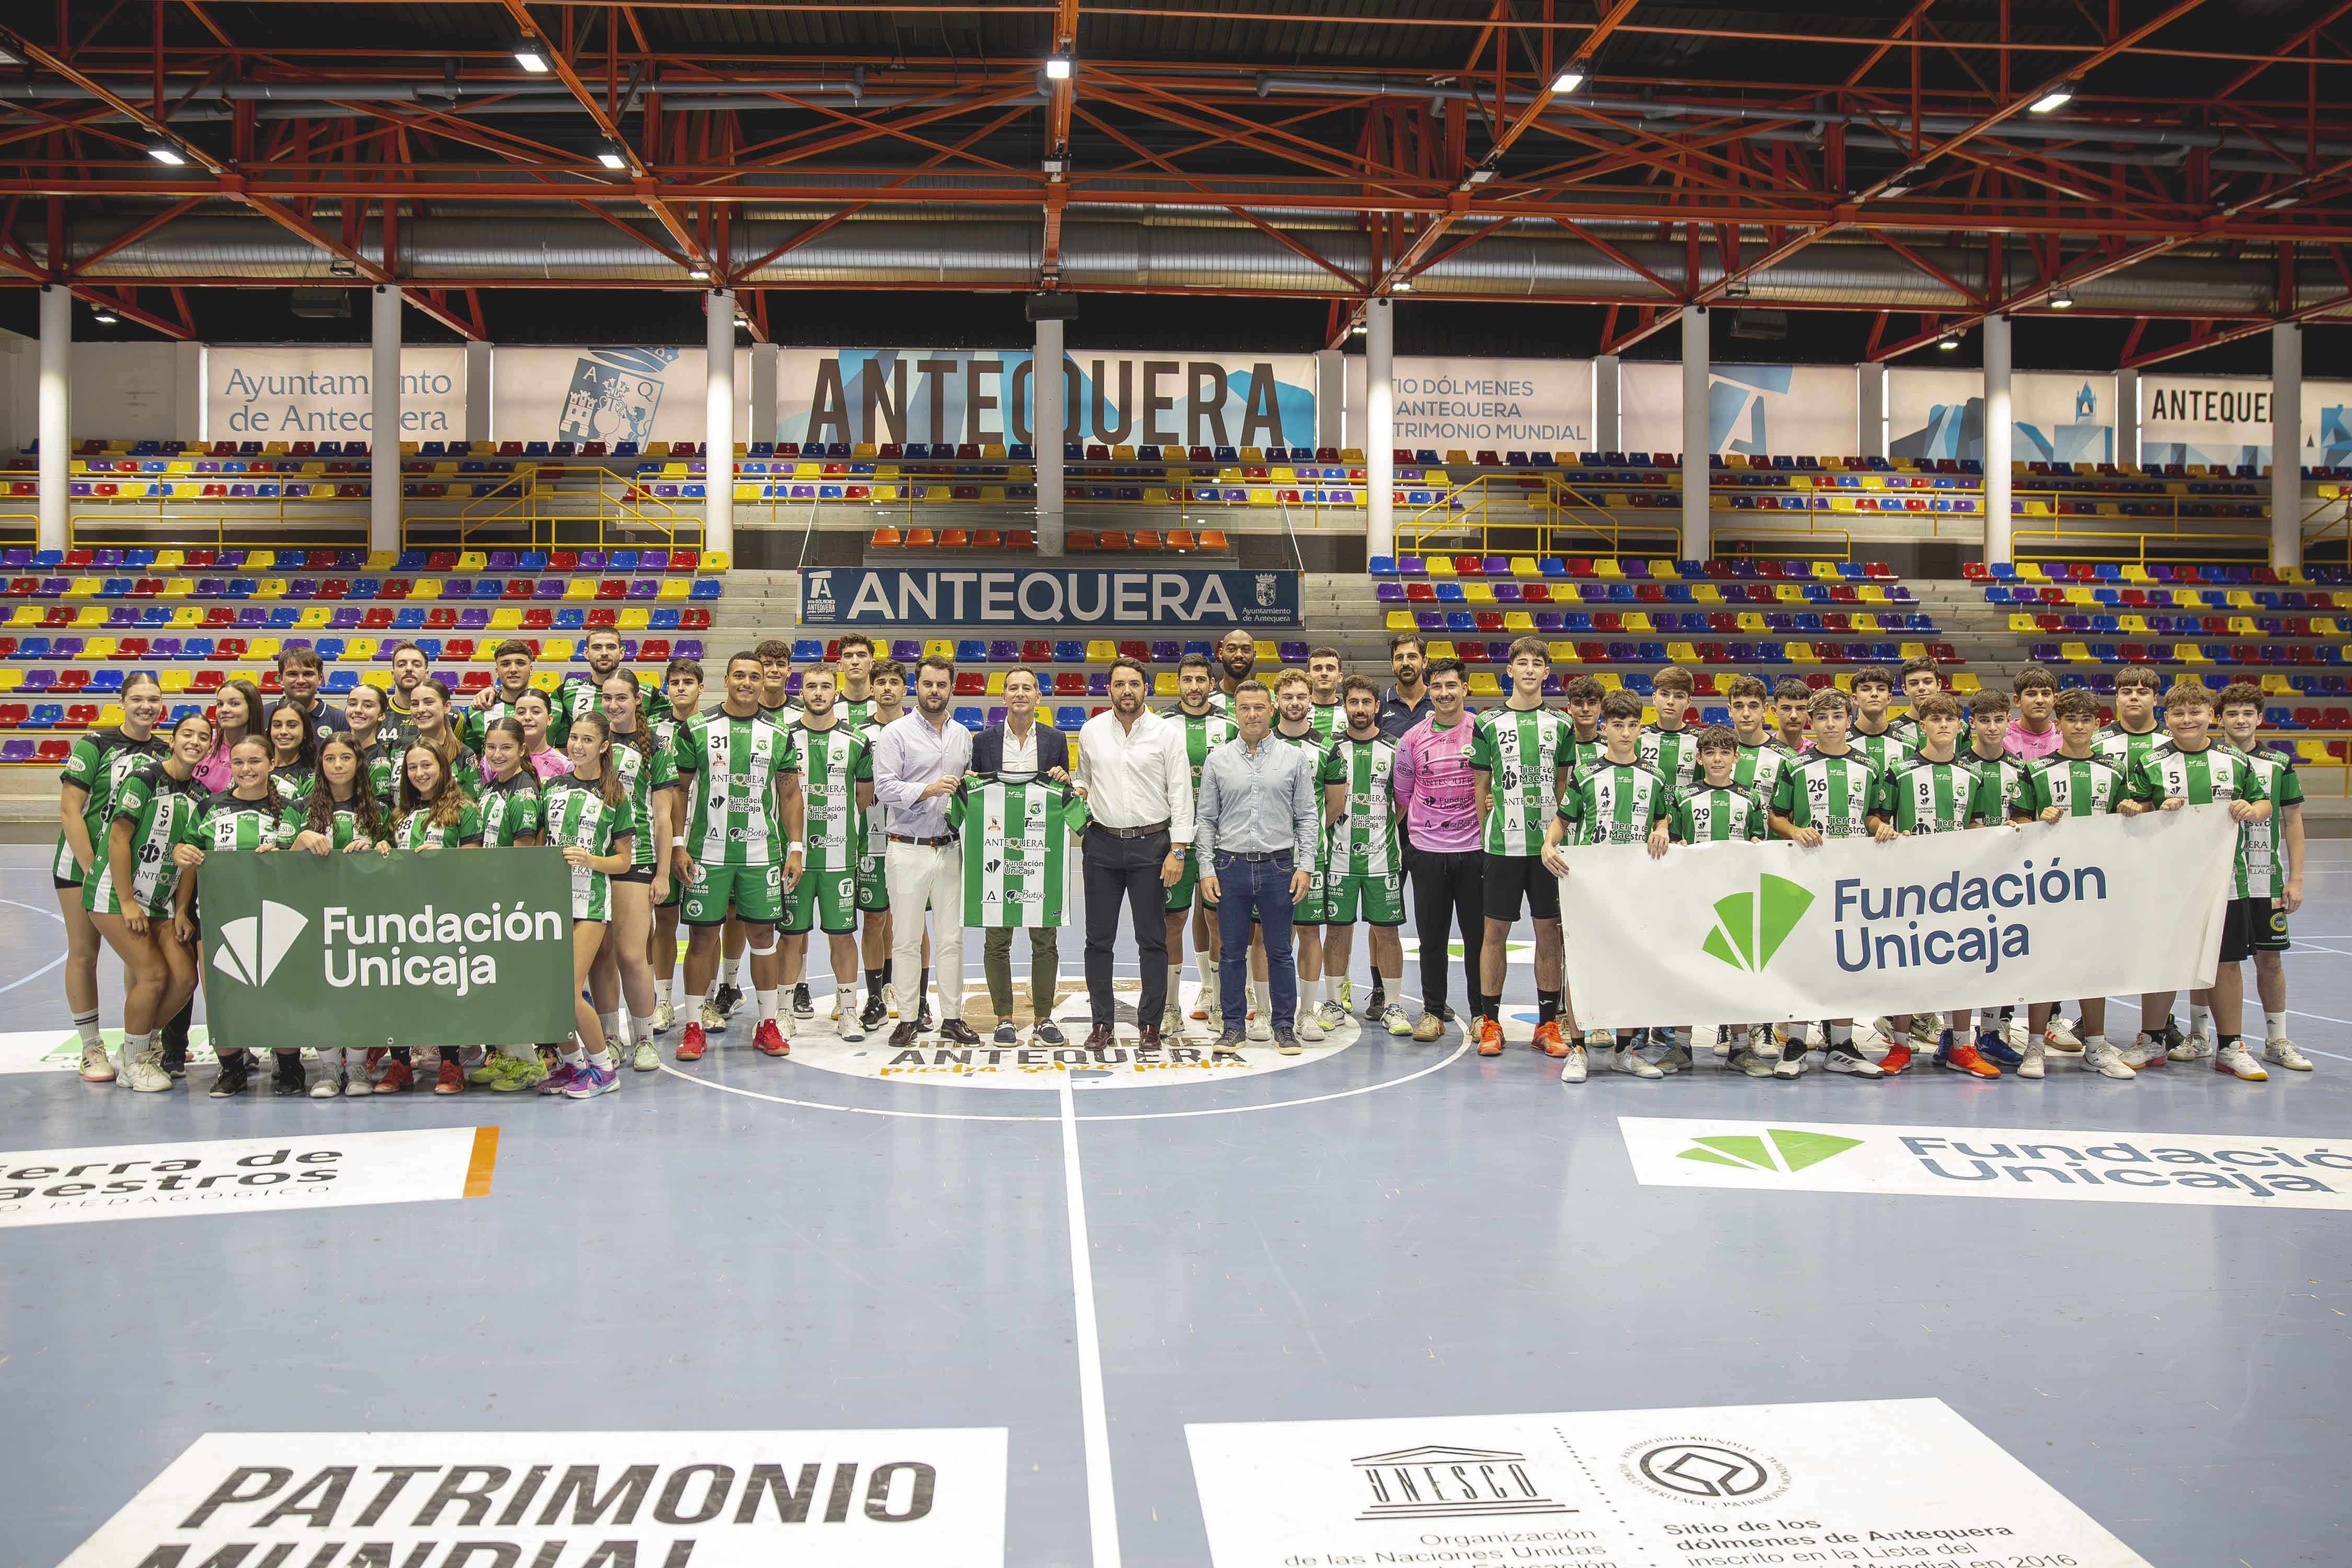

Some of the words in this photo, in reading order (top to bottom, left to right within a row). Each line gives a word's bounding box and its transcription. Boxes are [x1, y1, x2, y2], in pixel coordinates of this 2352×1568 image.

[582, 366, 597, 383] A
[225, 368, 452, 402] Ayuntamnto
[638, 382, 653, 402] Q
[1423, 375, 1534, 396] DÓLMENES
[806, 358, 1285, 446] ANTEQUERA
[1396, 400, 1522, 418] ANTEQUERA
[2152, 389, 2274, 422] ANTEQUE
[229, 405, 269, 431] de
[280, 405, 448, 432] Anteera
[1393, 422, 1491, 439] TRIMONIO
[1496, 424, 1587, 441] MUNDIAL
[847, 572, 1238, 622] ANTEQUERA
[579, 698, 587, 710] 2
[377, 728, 399, 741] 44
[1498, 730, 1517, 745] 25
[710, 735, 728, 749] 31
[1423, 750, 1429, 763] 1
[1642, 747, 1658, 759] 22
[118, 766, 126, 777] 7
[195, 765, 210, 777] 19
[2169, 771, 2180, 785] 5
[801, 784, 846, 795] TEQUERA
[1601, 786, 1610, 798] 4
[1807, 779, 1827, 792] 26
[1919, 783, 1929, 795] 8
[2053, 780, 2067, 793] 11
[549, 799, 566, 810] 22
[1346, 793, 1386, 805] TEQUERA
[1504, 795, 1556, 808] ANTEQUERA
[160, 805, 169, 818] 5
[729, 804, 760, 814] Unicaja
[1693, 808, 1709, 820] 29
[809, 812, 838, 821] Unicaja
[1826, 815, 1856, 824] Tierra
[1933, 819, 1964, 827] Tierra
[218, 823, 234, 835] 15
[397, 820, 412, 830] 88
[1352, 821, 1379, 830] Unicaja
[1610, 821, 1640, 830] Tierra
[558, 833, 584, 844] Tierra
[587, 836, 596, 846] de
[825, 834, 847, 845] Botijo
[985, 837, 1044, 851] ANTEQUERA
[1005, 867, 1035, 877] Unicaja
[1022, 890, 1045, 900] Botijo
[1835, 857, 2107, 922] Fundación
[324, 901, 562, 945] Fundación
[1835, 914, 2030, 973] Unicaja
[324, 946, 497, 997] Unicaja
[889, 1047, 1248, 1065] ANTEQUERA
[1899, 1136, 2352, 1170] Fundació
[0, 1158, 202, 1179] erra
[236, 1149, 343, 1167] de
[0, 1169, 339, 1199] aestros
[1919, 1157, 2339, 1198] Unicaja
[1365, 1463, 1538, 1503] UNESCO
[177, 1461, 936, 1529] PATRIMONIO
[1663, 1523, 1728, 1536] Sitio
[1738, 1521, 1768, 1532] de
[1778, 1518, 1822, 1530] los
[1420, 1529, 1597, 1547] Organización
[1676, 1534, 1817, 1552] dólmenes
[1824, 1531, 1860, 1545] de
[1868, 1526, 2015, 1543] Antequera
[1284, 1555, 1317, 1567] de
[1328, 1553, 1366, 1565] las
[1375, 1549, 1504, 1564] Naciones
[1511, 1544, 1607, 1558] Unidas
[1685, 1549, 1785, 1568] inscrito
[1793, 1550, 1827, 1562] en
[1831, 1548, 1862, 1560] la
[1863, 1544, 1930, 1559] Lista
[1936, 1542, 1978, 1555] del
[2009, 1554, 2078, 1568] 2016
